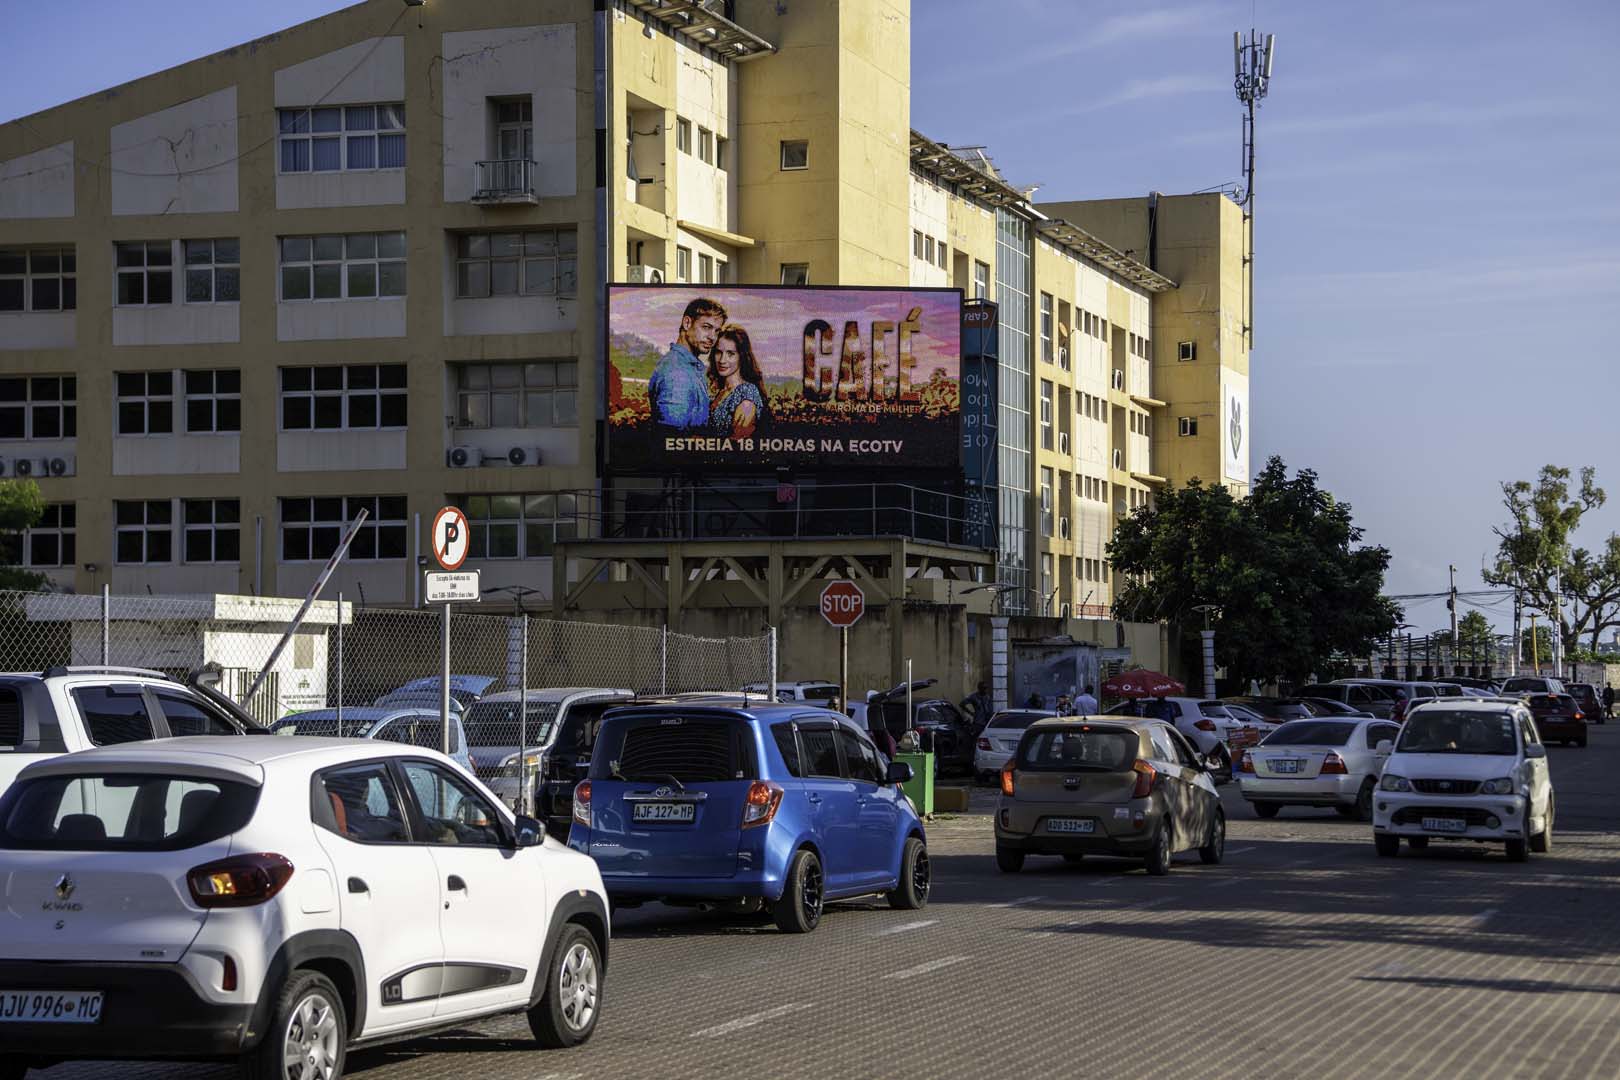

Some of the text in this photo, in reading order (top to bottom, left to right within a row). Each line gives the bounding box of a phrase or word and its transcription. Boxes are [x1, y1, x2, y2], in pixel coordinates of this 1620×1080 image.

[803, 306, 922, 401] CAFÉ
[868, 404, 881, 412] DE
[665, 438, 903, 453] ESTREIA 18 HORAS NA ECOTV
[823, 594, 861, 612] STOP
[634, 804, 693, 818] AJF 127 MP
[32, 995, 64, 1017] 996
[77, 996, 100, 1017] MC
